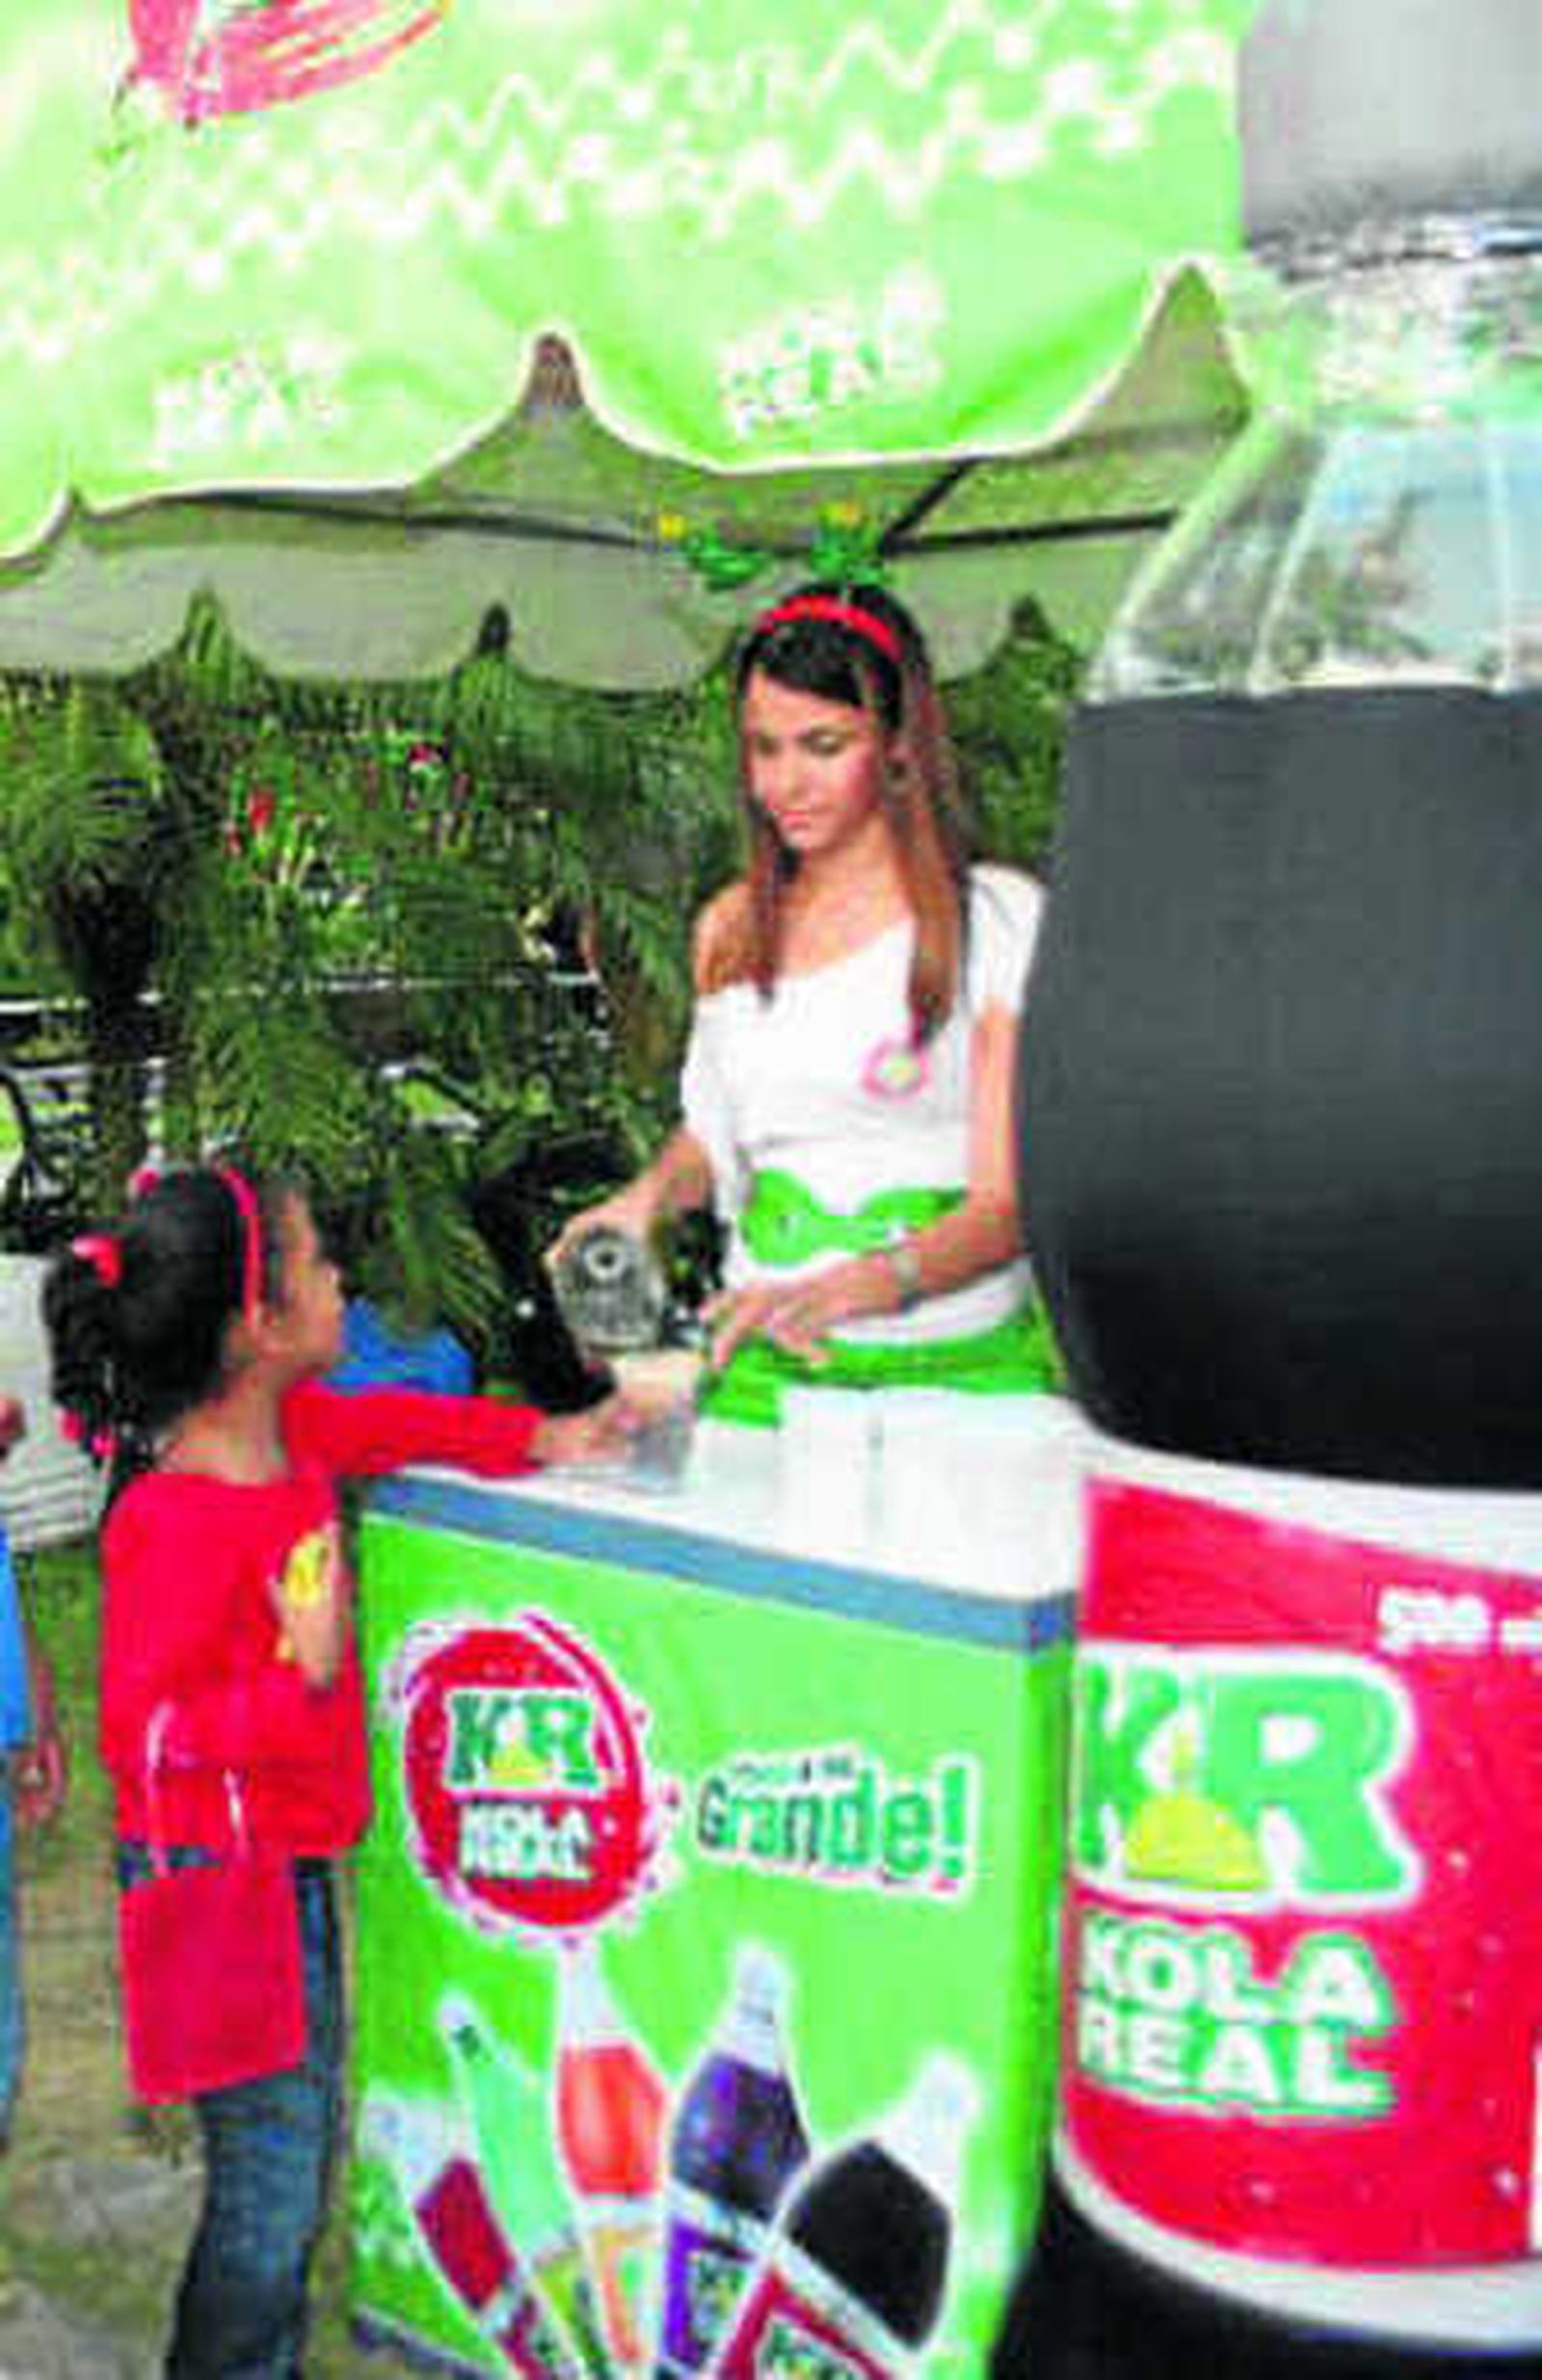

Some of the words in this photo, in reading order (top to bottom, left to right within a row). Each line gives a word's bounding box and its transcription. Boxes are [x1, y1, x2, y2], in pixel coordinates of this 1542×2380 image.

[449, 1692, 601, 1787] KR
[1072, 1650, 1417, 1904] KR
[696, 1764, 968, 1881] Grande!
[1079, 1918, 1396, 2030] KOLA
[1079, 2005, 1397, 2117] REAL
